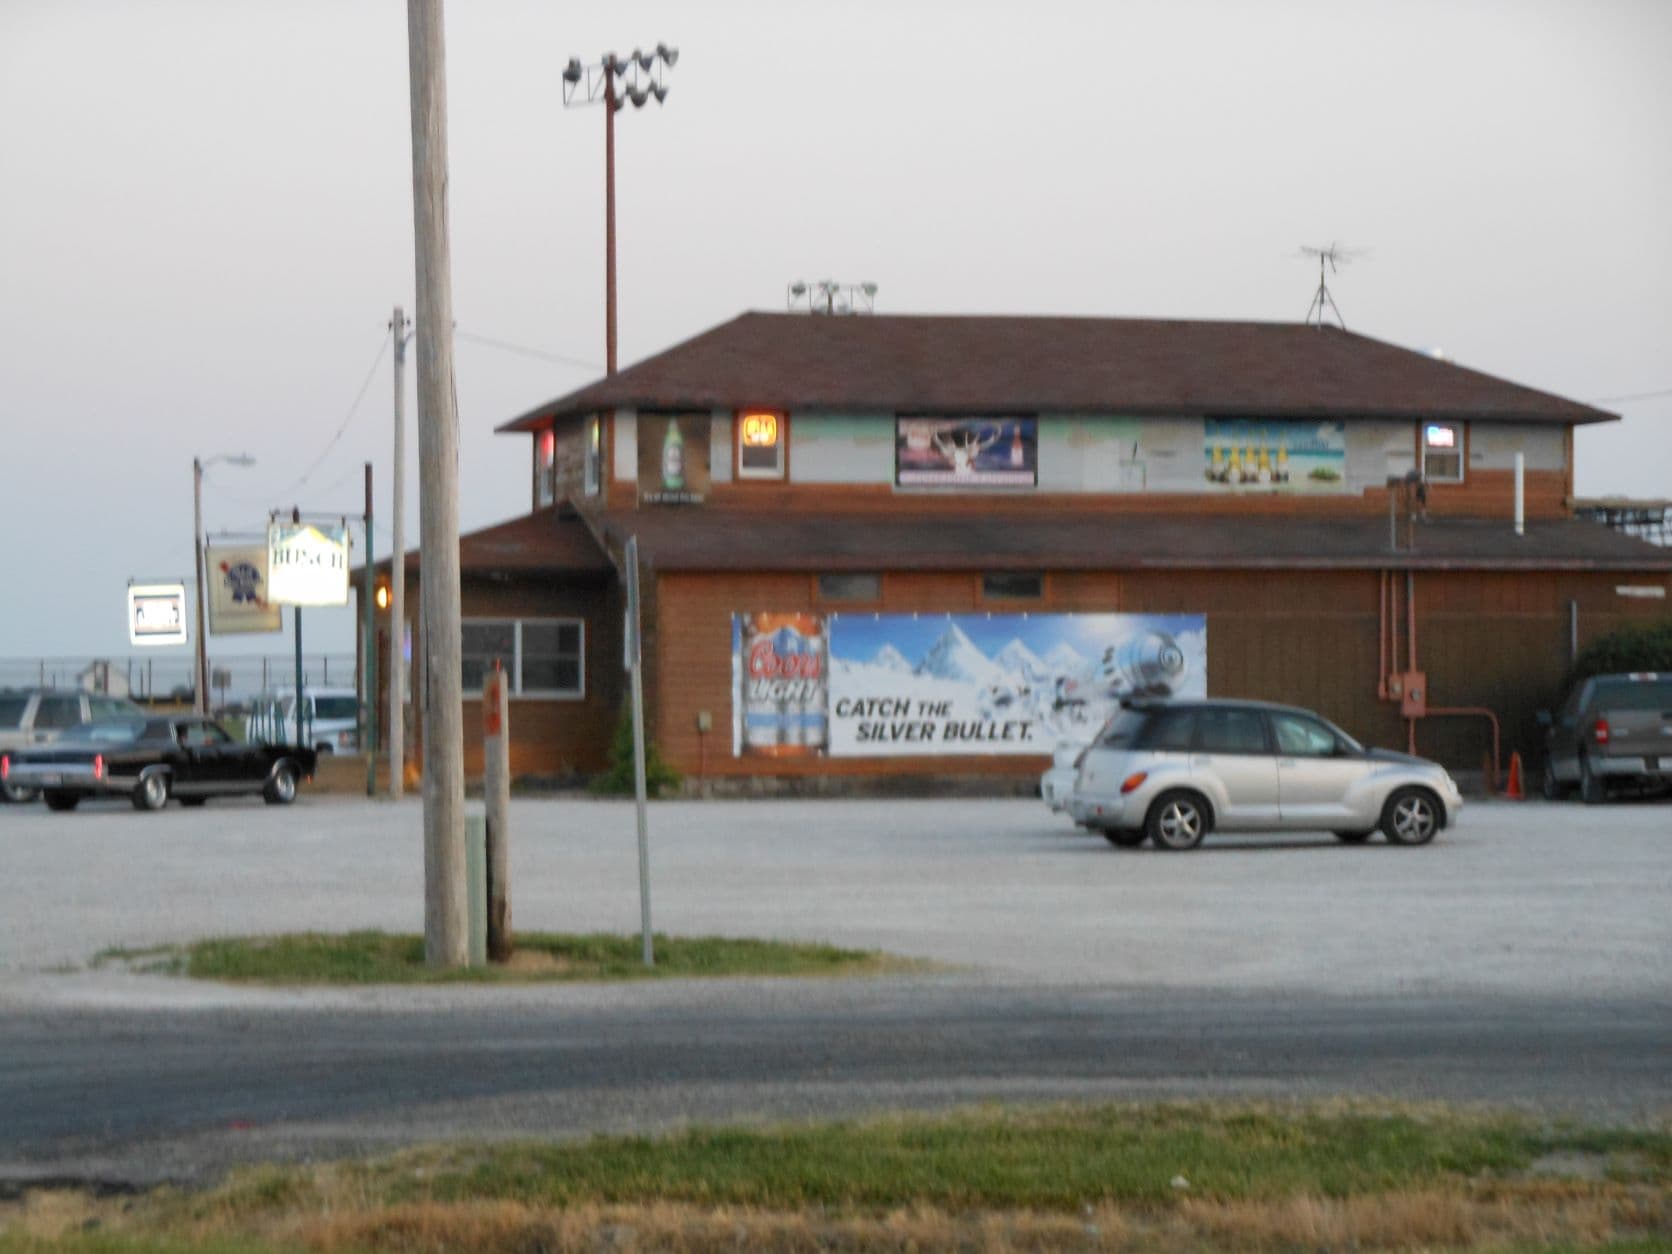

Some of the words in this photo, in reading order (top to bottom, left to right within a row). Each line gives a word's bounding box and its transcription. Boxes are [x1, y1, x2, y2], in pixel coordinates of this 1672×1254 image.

[272, 547, 343, 570] BUSCH
[836, 698, 910, 718] CATCH
[918, 700, 953, 718] THE
[855, 721, 936, 742] SILVER
[943, 720, 1034, 742] BULLET.
